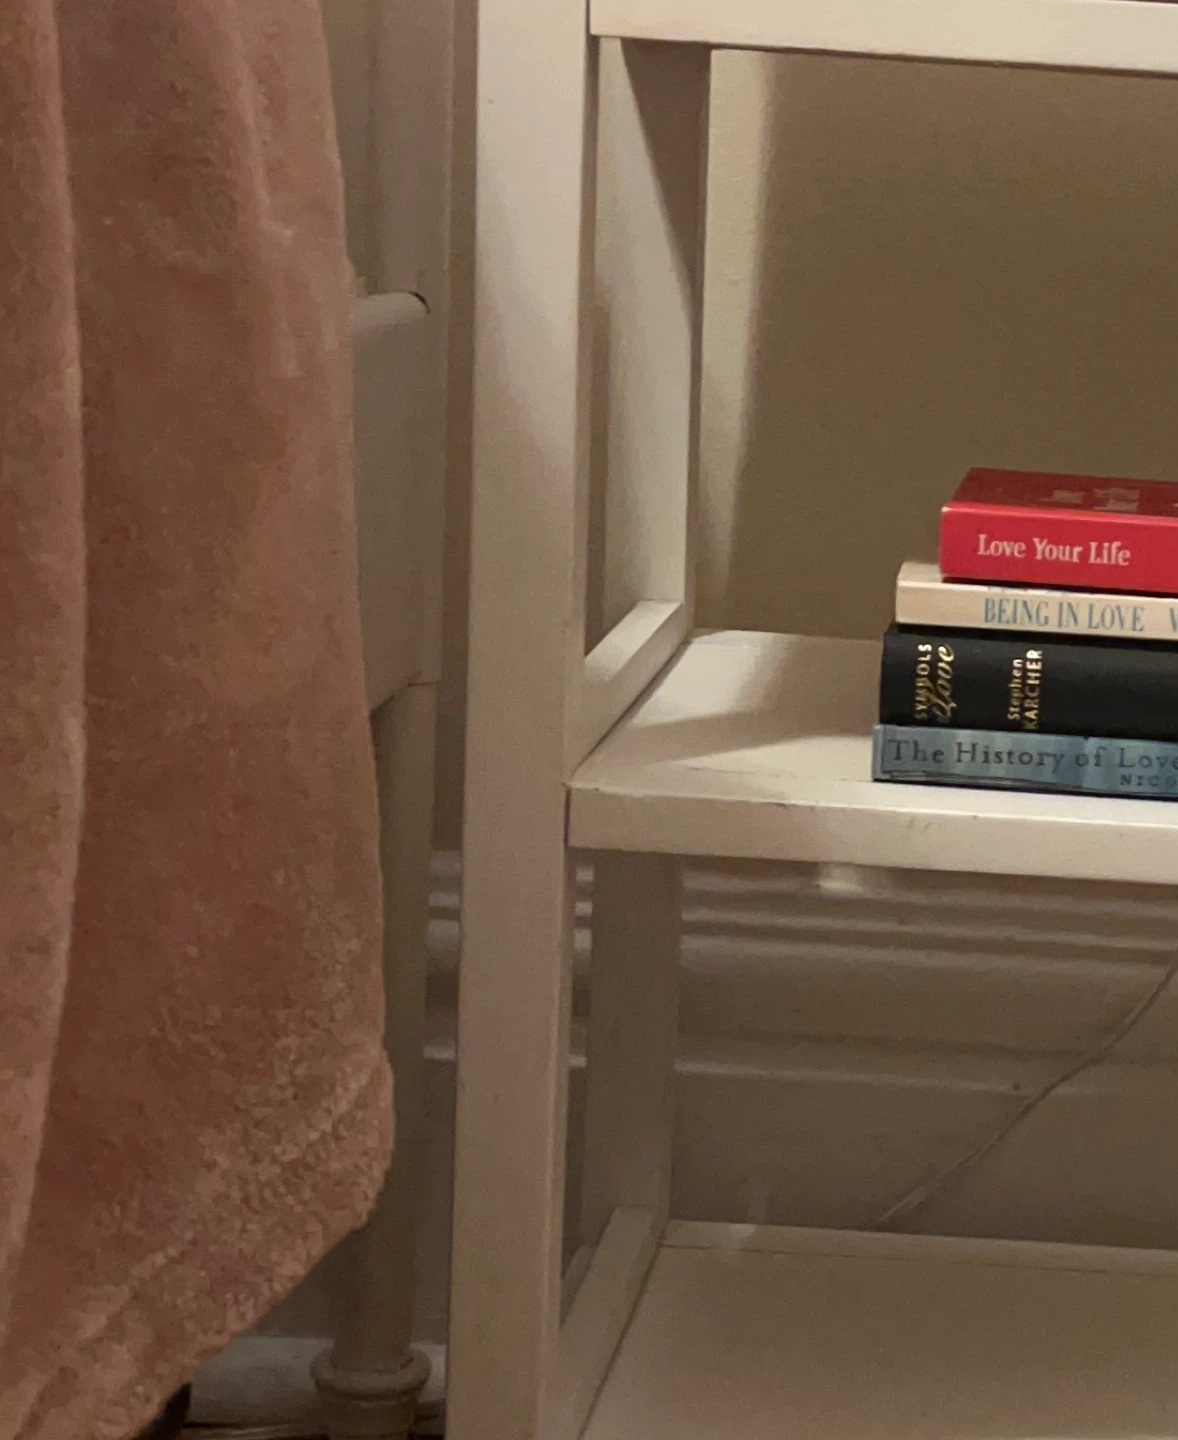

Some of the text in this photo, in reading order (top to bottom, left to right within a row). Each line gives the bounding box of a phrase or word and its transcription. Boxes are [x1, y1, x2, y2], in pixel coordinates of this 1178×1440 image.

[978, 534, 1131, 566] Love Your Life
[984, 597, 1146, 632] BEING IN LOVE
[914, 643, 933, 720] SYMBOLS
[1007, 658, 1023, 720] Stephen
[1023, 649, 1043, 729] KARCHER
[887, 739, 945, 763] The
[956, 742, 1066, 773] History
[1075, 746, 1108, 768] of
